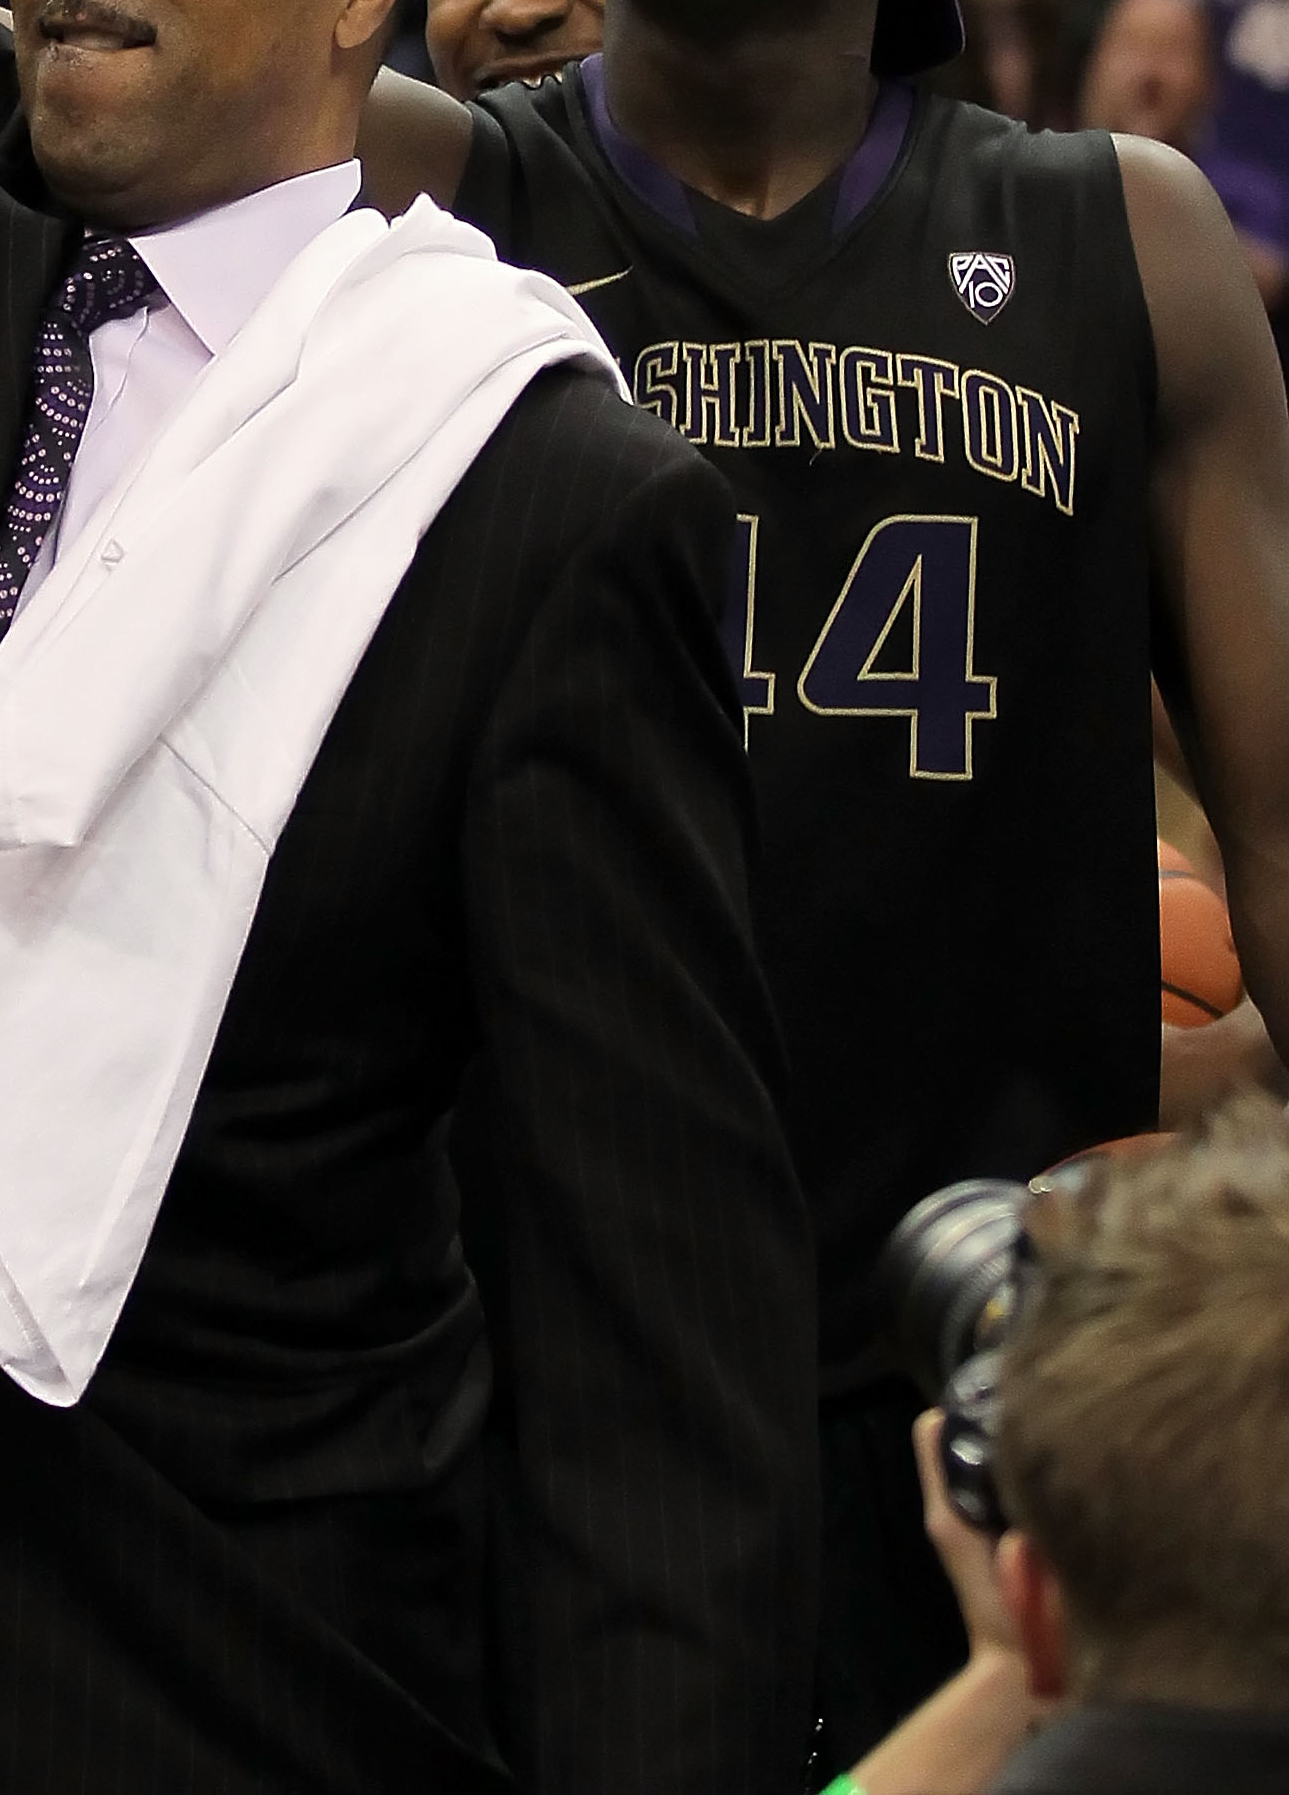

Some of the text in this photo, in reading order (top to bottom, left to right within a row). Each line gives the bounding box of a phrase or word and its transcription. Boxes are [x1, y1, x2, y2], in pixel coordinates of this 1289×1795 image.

[951, 255, 1011, 293] PAC
[966, 281, 1004, 309] 10
[631, 338, 1081, 516] SHINGTON
[735, 513, 998, 782] 4
